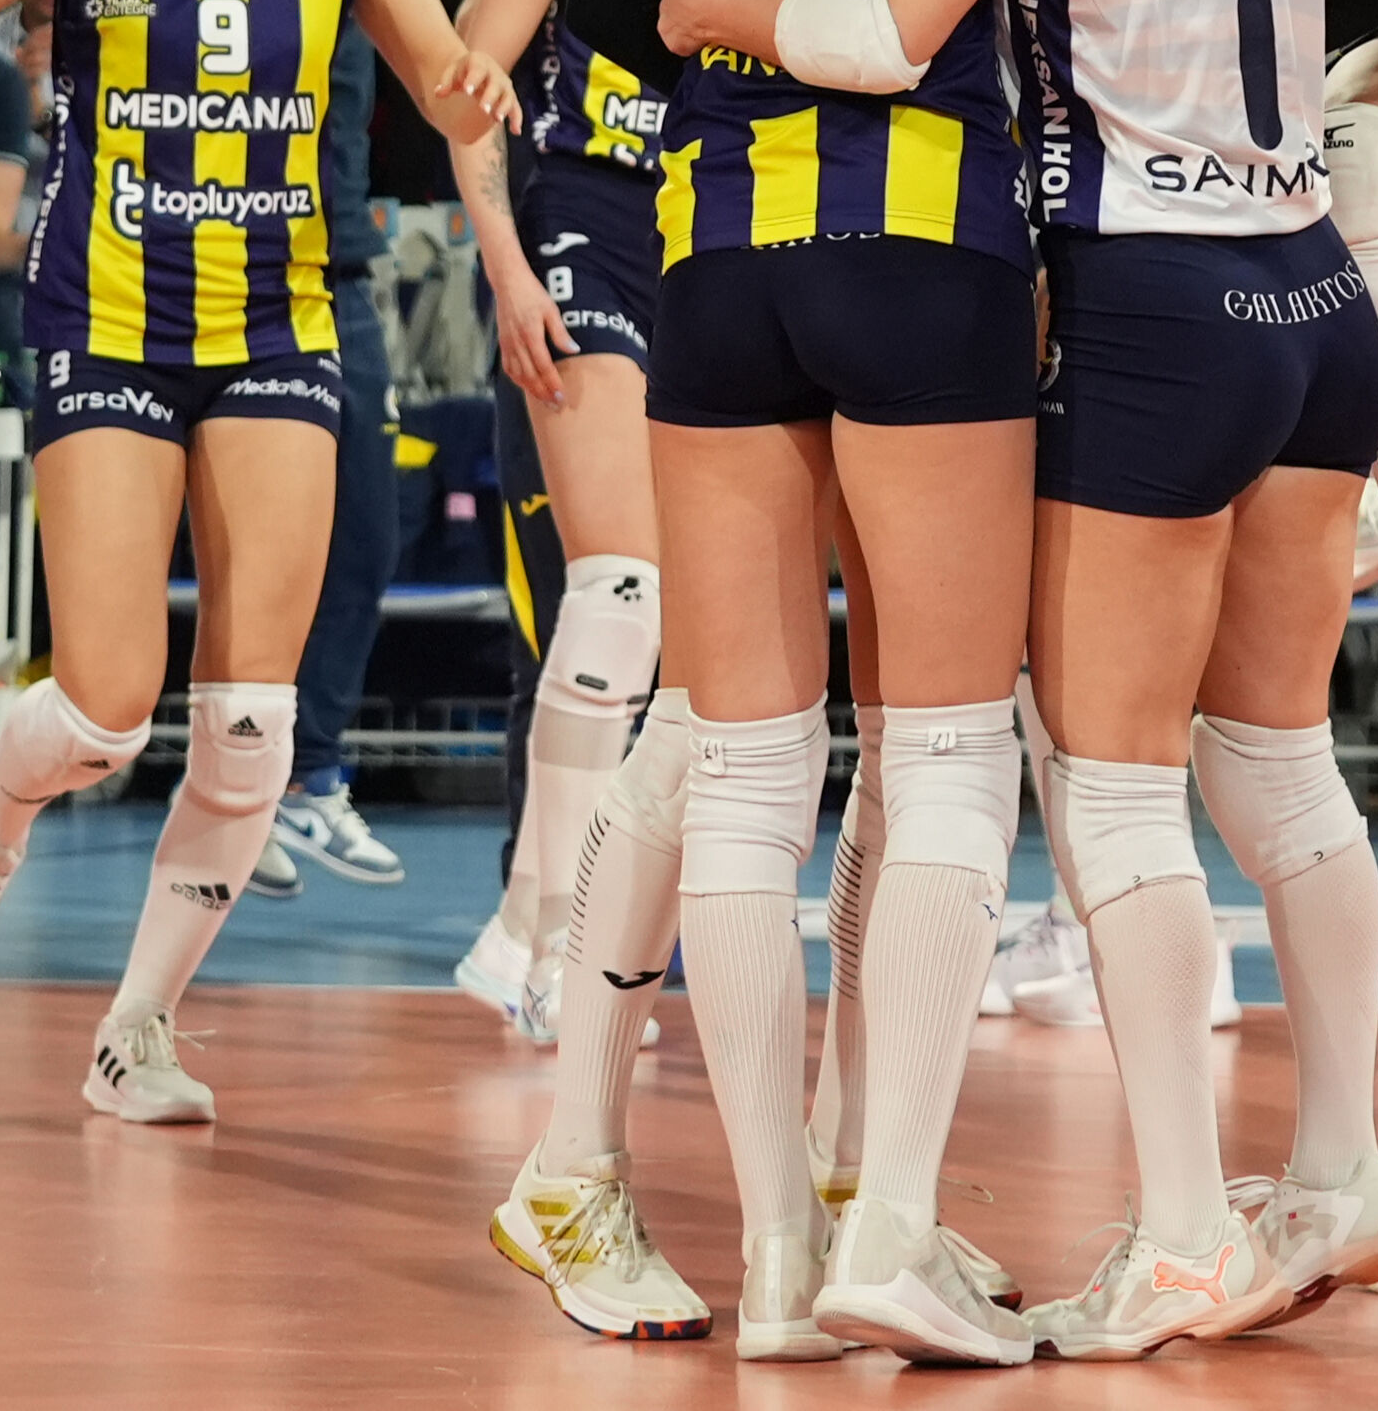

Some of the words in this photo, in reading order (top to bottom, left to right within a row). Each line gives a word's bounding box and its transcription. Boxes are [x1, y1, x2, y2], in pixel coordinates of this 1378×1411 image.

[104, 3, 157, 17] ENTEGRE
[152, 183, 311, 222] topluyoruz
[1224, 260, 1366, 324] GALAKTOS
[49, 350, 72, 389] 9
[57, 386, 174, 424] arsaVev
